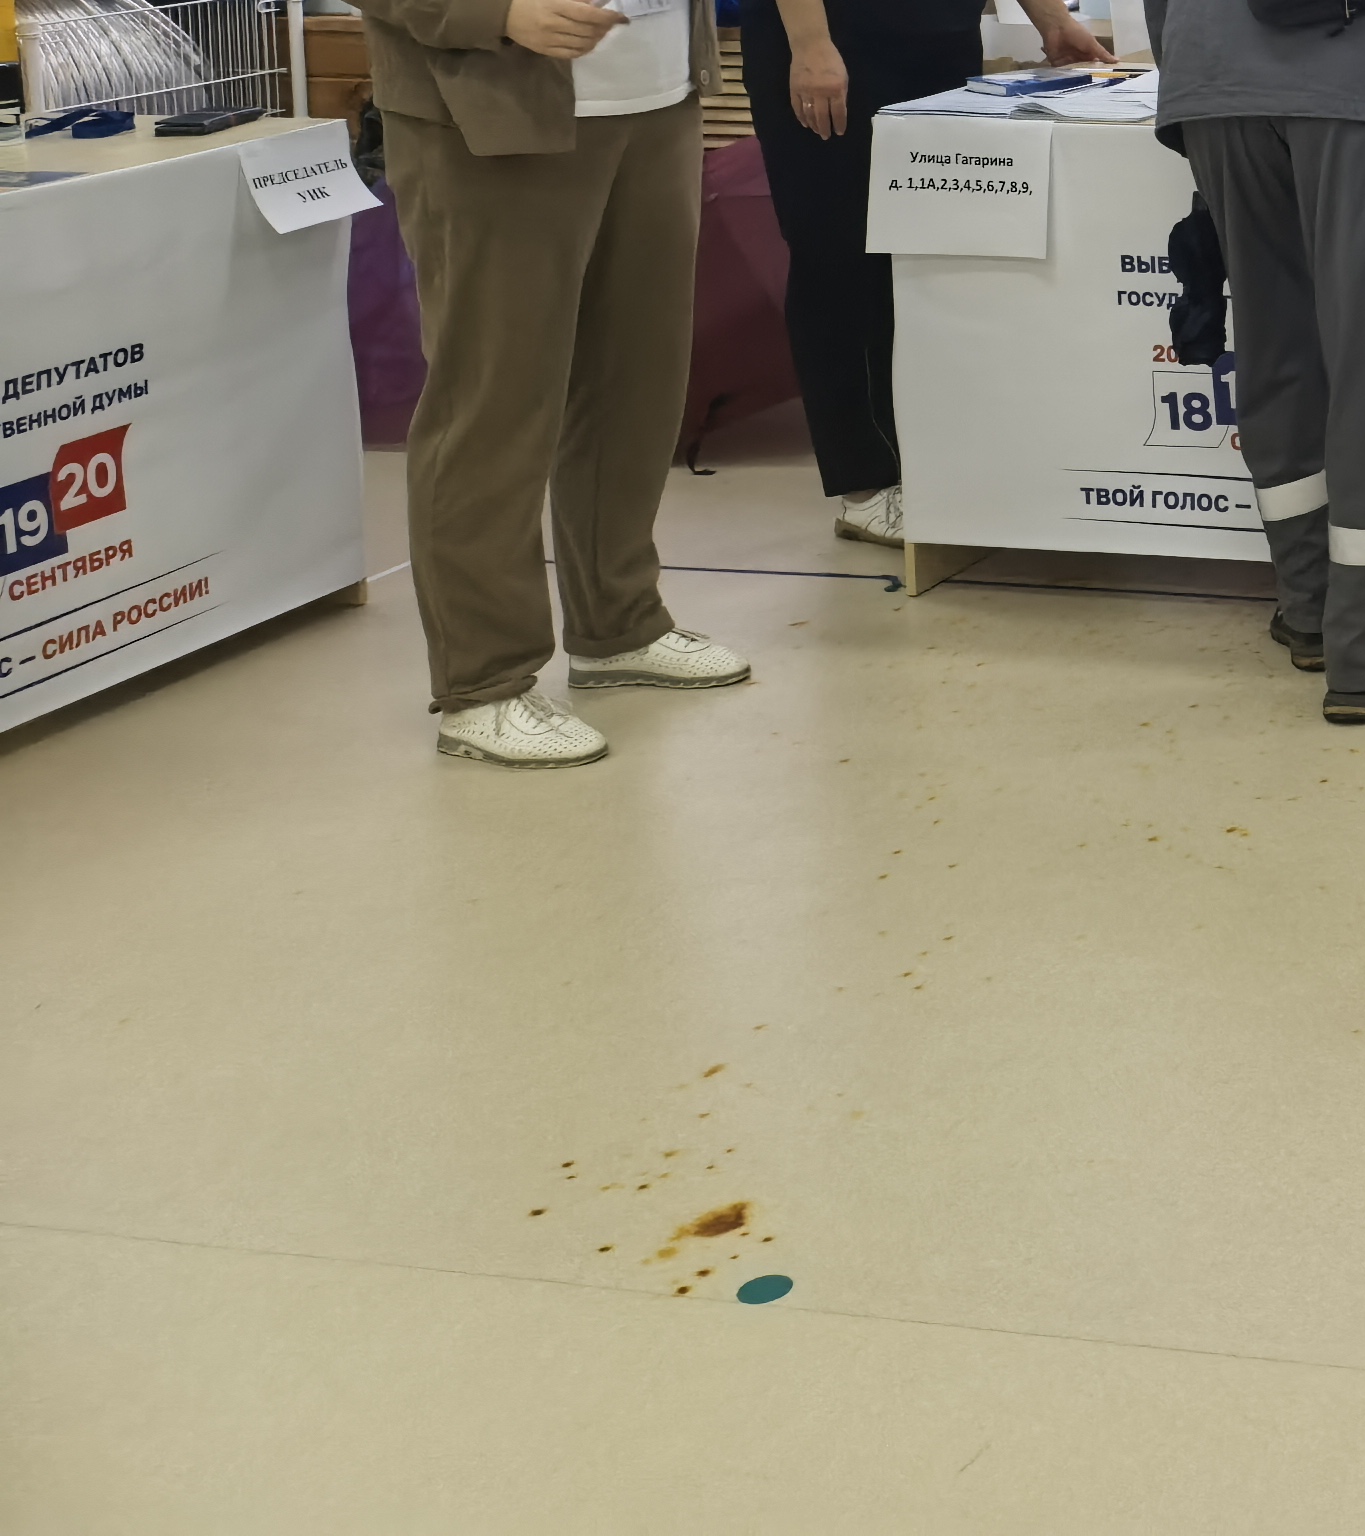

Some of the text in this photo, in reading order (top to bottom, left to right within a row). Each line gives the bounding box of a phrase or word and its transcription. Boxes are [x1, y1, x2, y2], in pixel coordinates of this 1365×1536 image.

[252, 158, 348, 190] ПРЕДСЕДАТЕЛЬ
[909, 151, 1014, 168] Улица Гагарина
[296, 186, 331, 203] УИК
[888, 179, 903, 191] д.
[1120, 254, 1172, 274] ВЫБ
[1117, 290, 1179, 310] ГОСУД
[1152, 344, 1180, 363] 20
[1, 343, 145, 404] ДЕПУТАТОВ
[91, 379, 149, 414] ДУМЫ
[1160, 391, 1213, 432] 18
[57, 452, 117, 512] 20
[1080, 484, 1145, 508] ТВОЙ
[1151, 490, 1229, 512] ГОЛОС
[8, 538, 134, 602] СЕНТЯБРЯ
[42, 619, 107, 660] СИЛА
[112, 576, 209, 633] РОССИИ!
